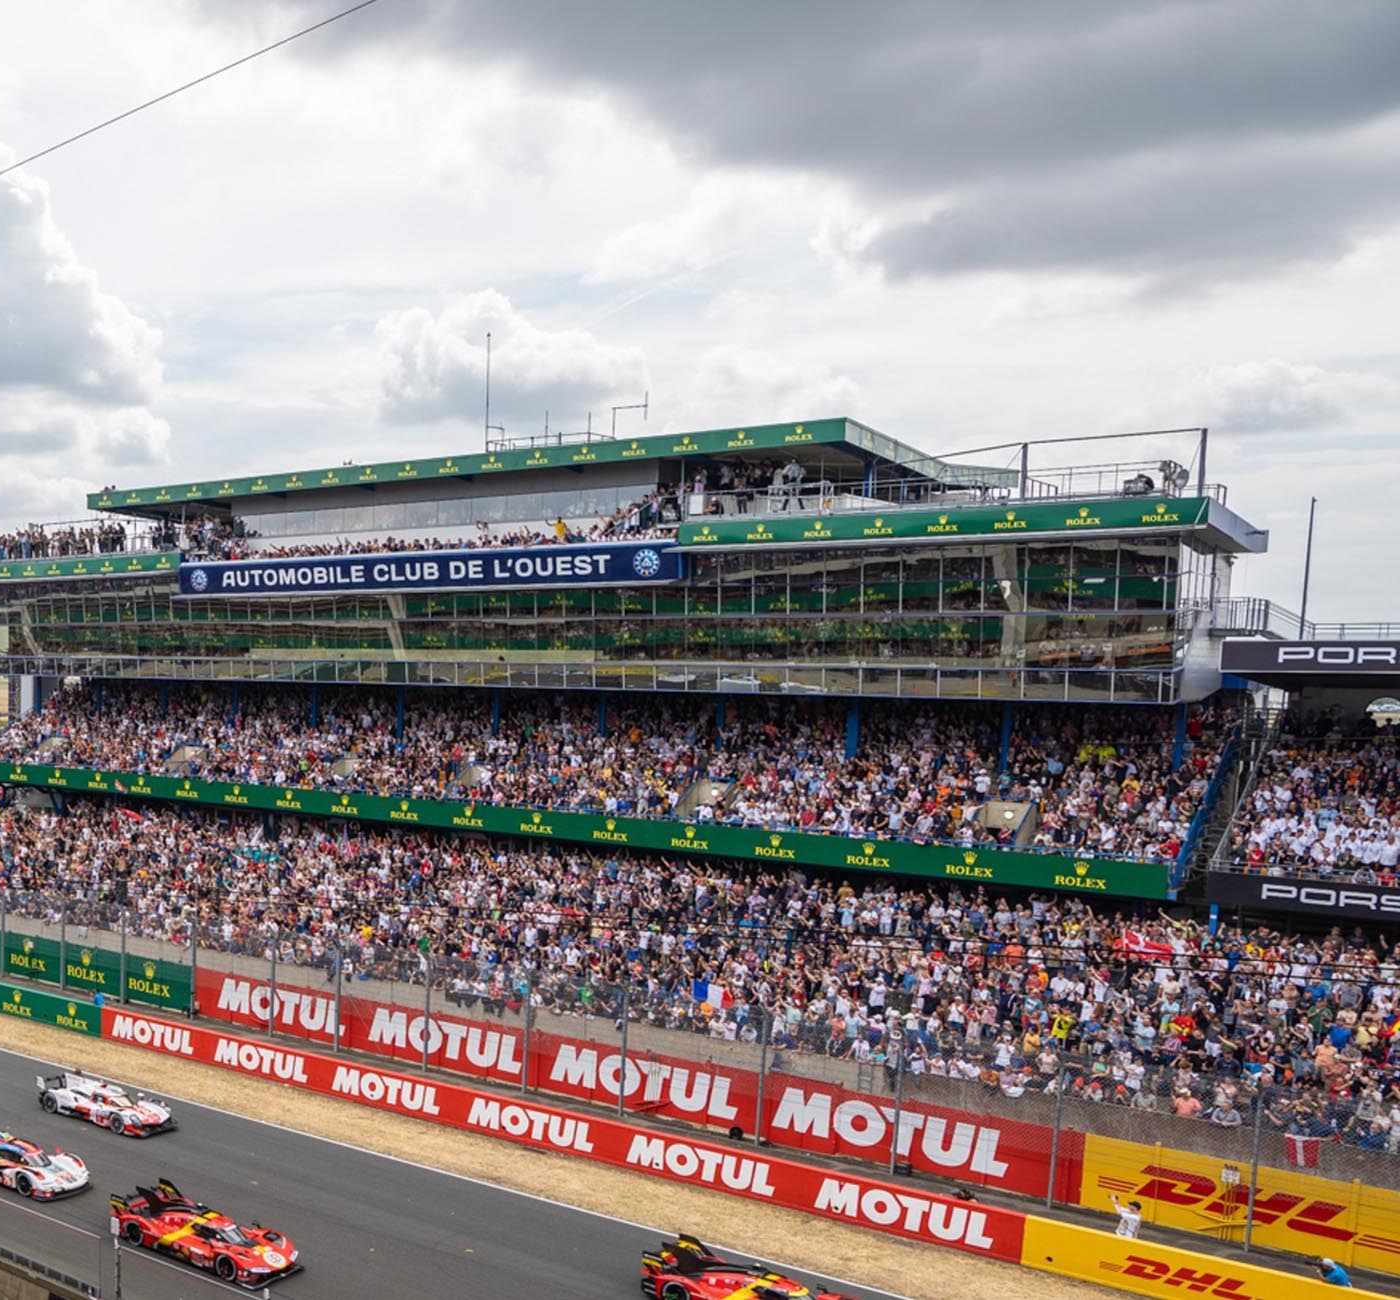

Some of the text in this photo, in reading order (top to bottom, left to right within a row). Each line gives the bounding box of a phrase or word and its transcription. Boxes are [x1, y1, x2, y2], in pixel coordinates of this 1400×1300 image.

[728, 439, 754, 447] ROLEX
[785, 434, 813, 442] ROLEX
[673, 444, 698, 452] ROLEX
[1066, 515, 1100, 525] ROLEX
[1141, 512, 1179, 523] ROLEX
[863, 526, 893, 535] ROLEX
[927, 523, 958, 532] ROLEX
[994, 520, 1027, 529] ROLEX
[747, 532, 773, 540] ROLEX
[804, 529, 831, 538] ROLEX
[222, 554, 611, 588] AUTOMOBILE CLUB DE L'OUEST
[131, 785, 150, 793] ROLEX
[176, 790, 198, 798] ROLEX
[224, 794, 247, 803] ROLEX
[276, 799, 300, 809] ROLEX
[331, 805, 357, 815] ROLEX
[390, 810, 418, 820] ROLEX
[453, 817, 482, 827] ROLEX
[520, 823, 552, 834] ROLEX
[593, 831, 627, 842] ROLEX
[671, 838, 708, 850] ROLEX
[755, 846, 794, 859] ROLEX
[846, 855, 890, 868] ROLEX
[945, 864, 992, 878] ROLEX
[1054, 875, 1106, 889] ROLEX
[67, 965, 105, 984] ROLEX
[128, 978, 170, 997] ROLEX
[2, 1002, 31, 1016] ROLEX
[217, 977, 346, 1037] MOTUL
[56, 1014, 88, 1030] ROLEX
[112, 1014, 193, 1055] MOTUL
[368, 1007, 522, 1075] MOTUL
[214, 1038, 308, 1083] MOTUL
[550, 1043, 738, 1120] MOTUL
[332, 1065, 440, 1115] MOTUL
[467, 1096, 594, 1153] MOTUL
[771, 1087, 1009, 1178] MOTUL
[626, 1134, 776, 1197] MOTUL
[1135, 1164, 1358, 1242] DHL
[814, 1177, 993, 1250] MOTUL
[1122, 1255, 1253, 1300] DHL
